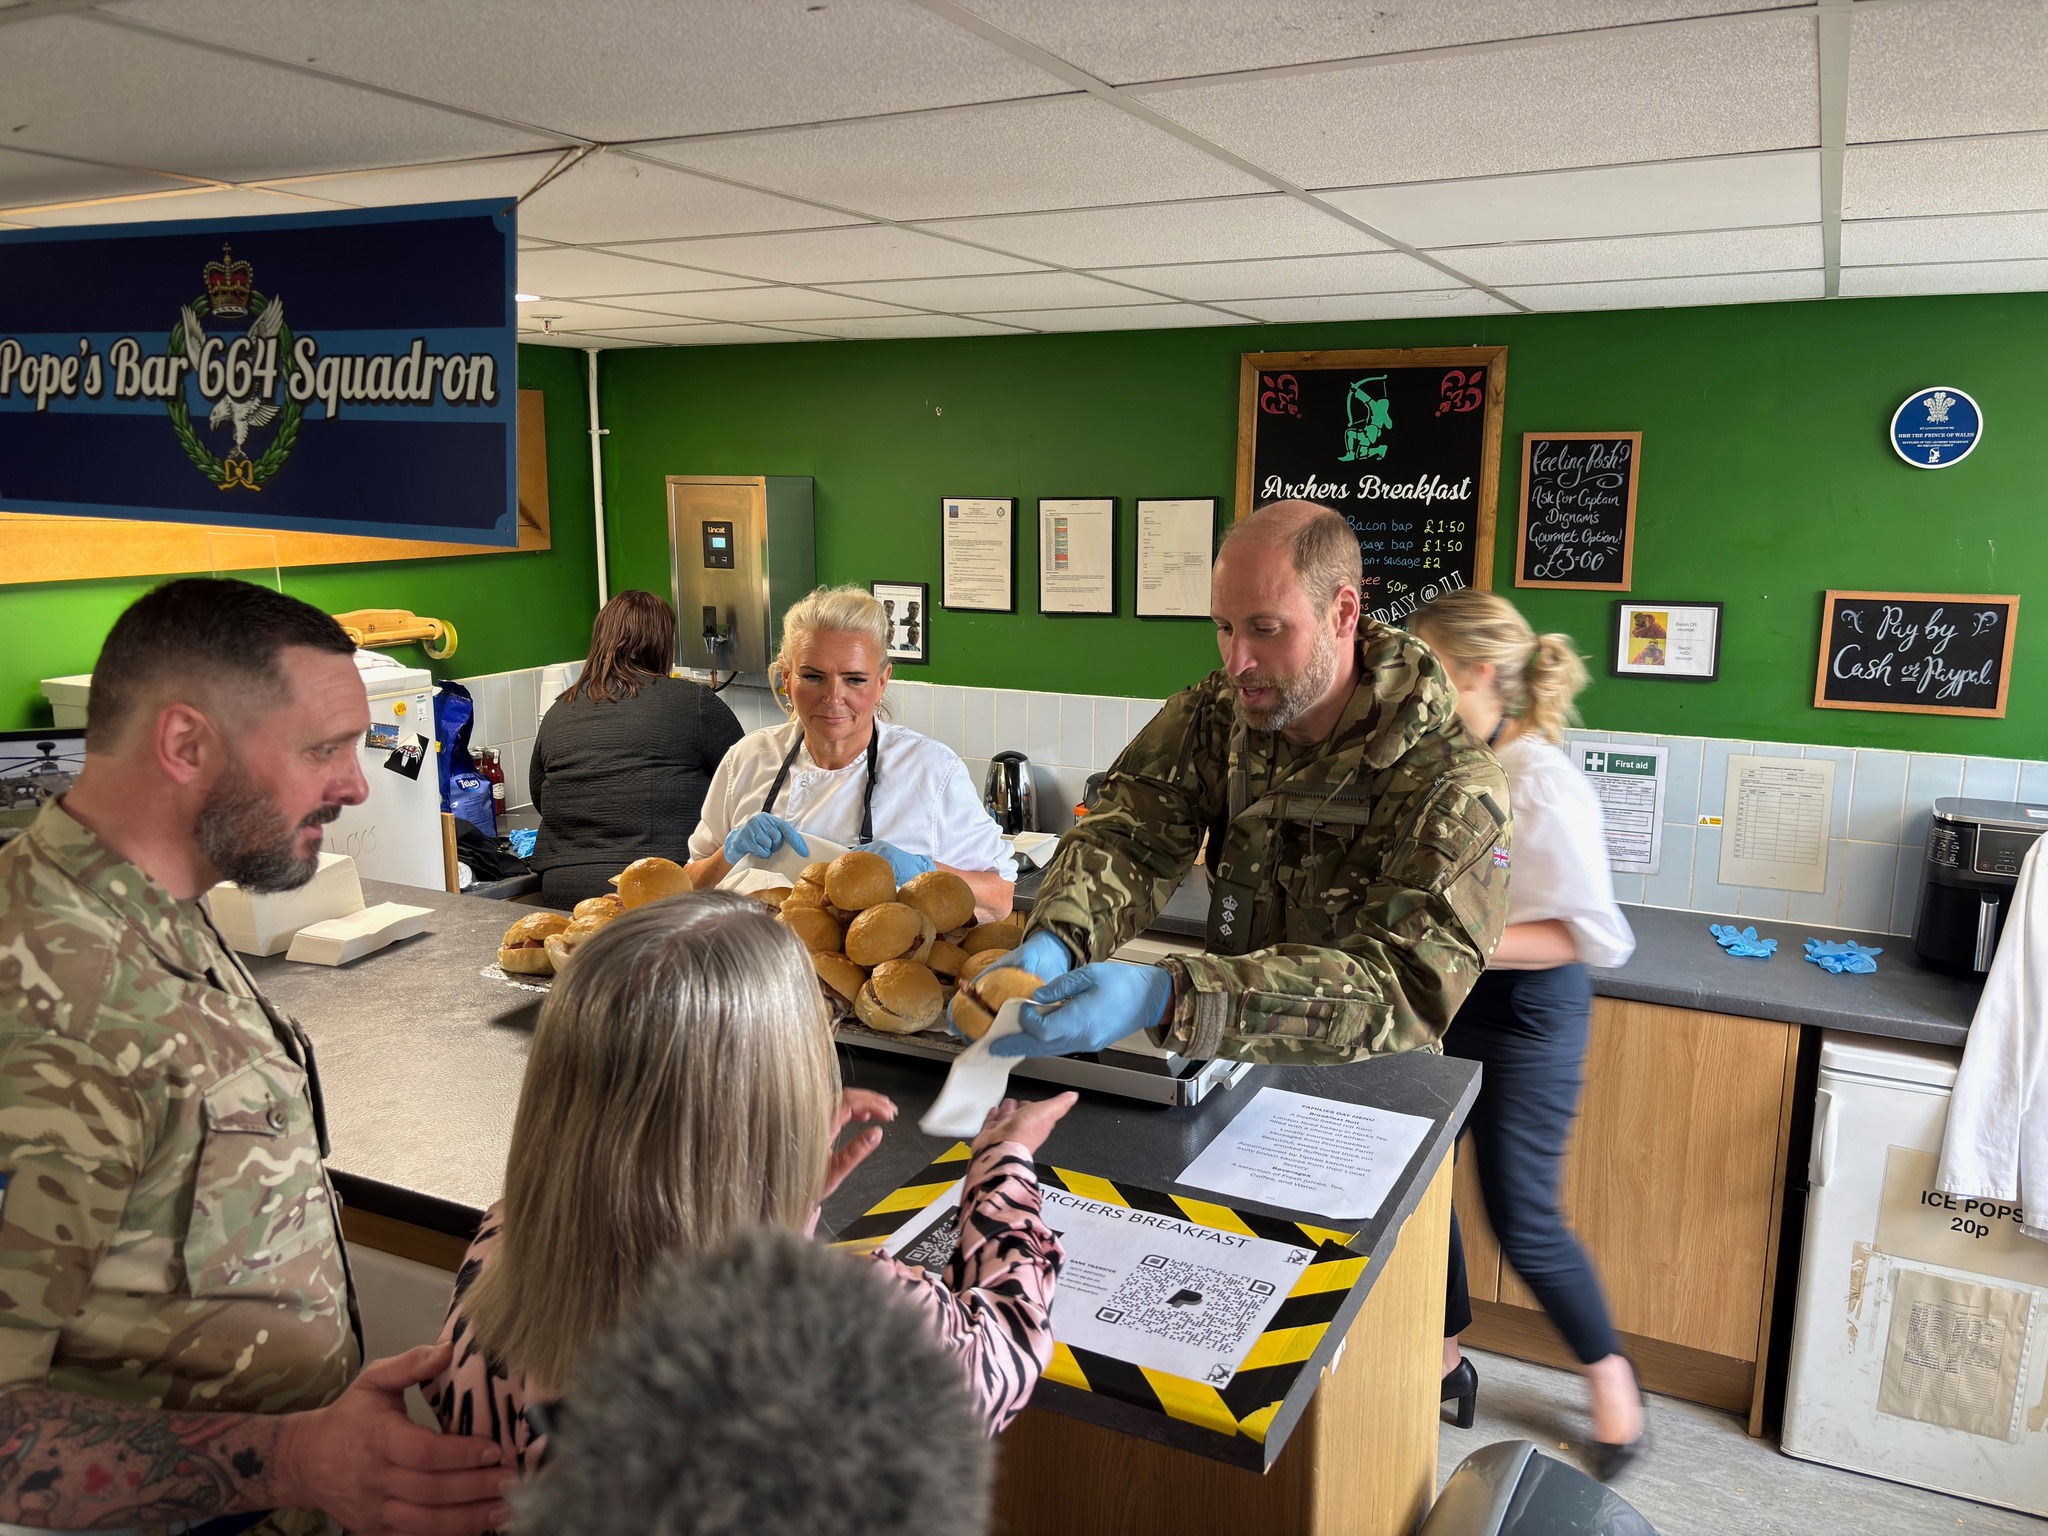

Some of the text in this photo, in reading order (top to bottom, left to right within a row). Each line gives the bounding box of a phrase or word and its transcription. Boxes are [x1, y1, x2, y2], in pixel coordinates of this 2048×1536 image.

[0, 336, 496, 420] Pope's Bar 664 Squadron
[1533, 441, 1630, 488] Feeling Posh?
[1260, 474, 1472, 506] Archers Breakfast
[1532, 485, 1620, 510] Ask for Captain
[1346, 515, 1387, 531] Bacon
[1391, 519, 1413, 532] bap
[1529, 522, 1623, 549] Gourmet Option!
[1391, 539, 1413, 551] bap
[1383, 556, 1420, 568] sausage
[1423, 557, 1440, 569] £2
[1387, 580, 1408, 593] 50p
[1876, 605, 1959, 654] Pay by
[1833, 644, 1894, 686] Cash
[1615, 760, 1648, 770] First aid
[1302, 1104, 1334, 1114] FAMILIES
[1309, 1112, 1343, 1121] Breakfast
[1921, 1191, 2023, 1224] ICE POPS
[1128, 1212, 1251, 1249] BREAKFAST
[1950, 1217, 1989, 1239] 20p
